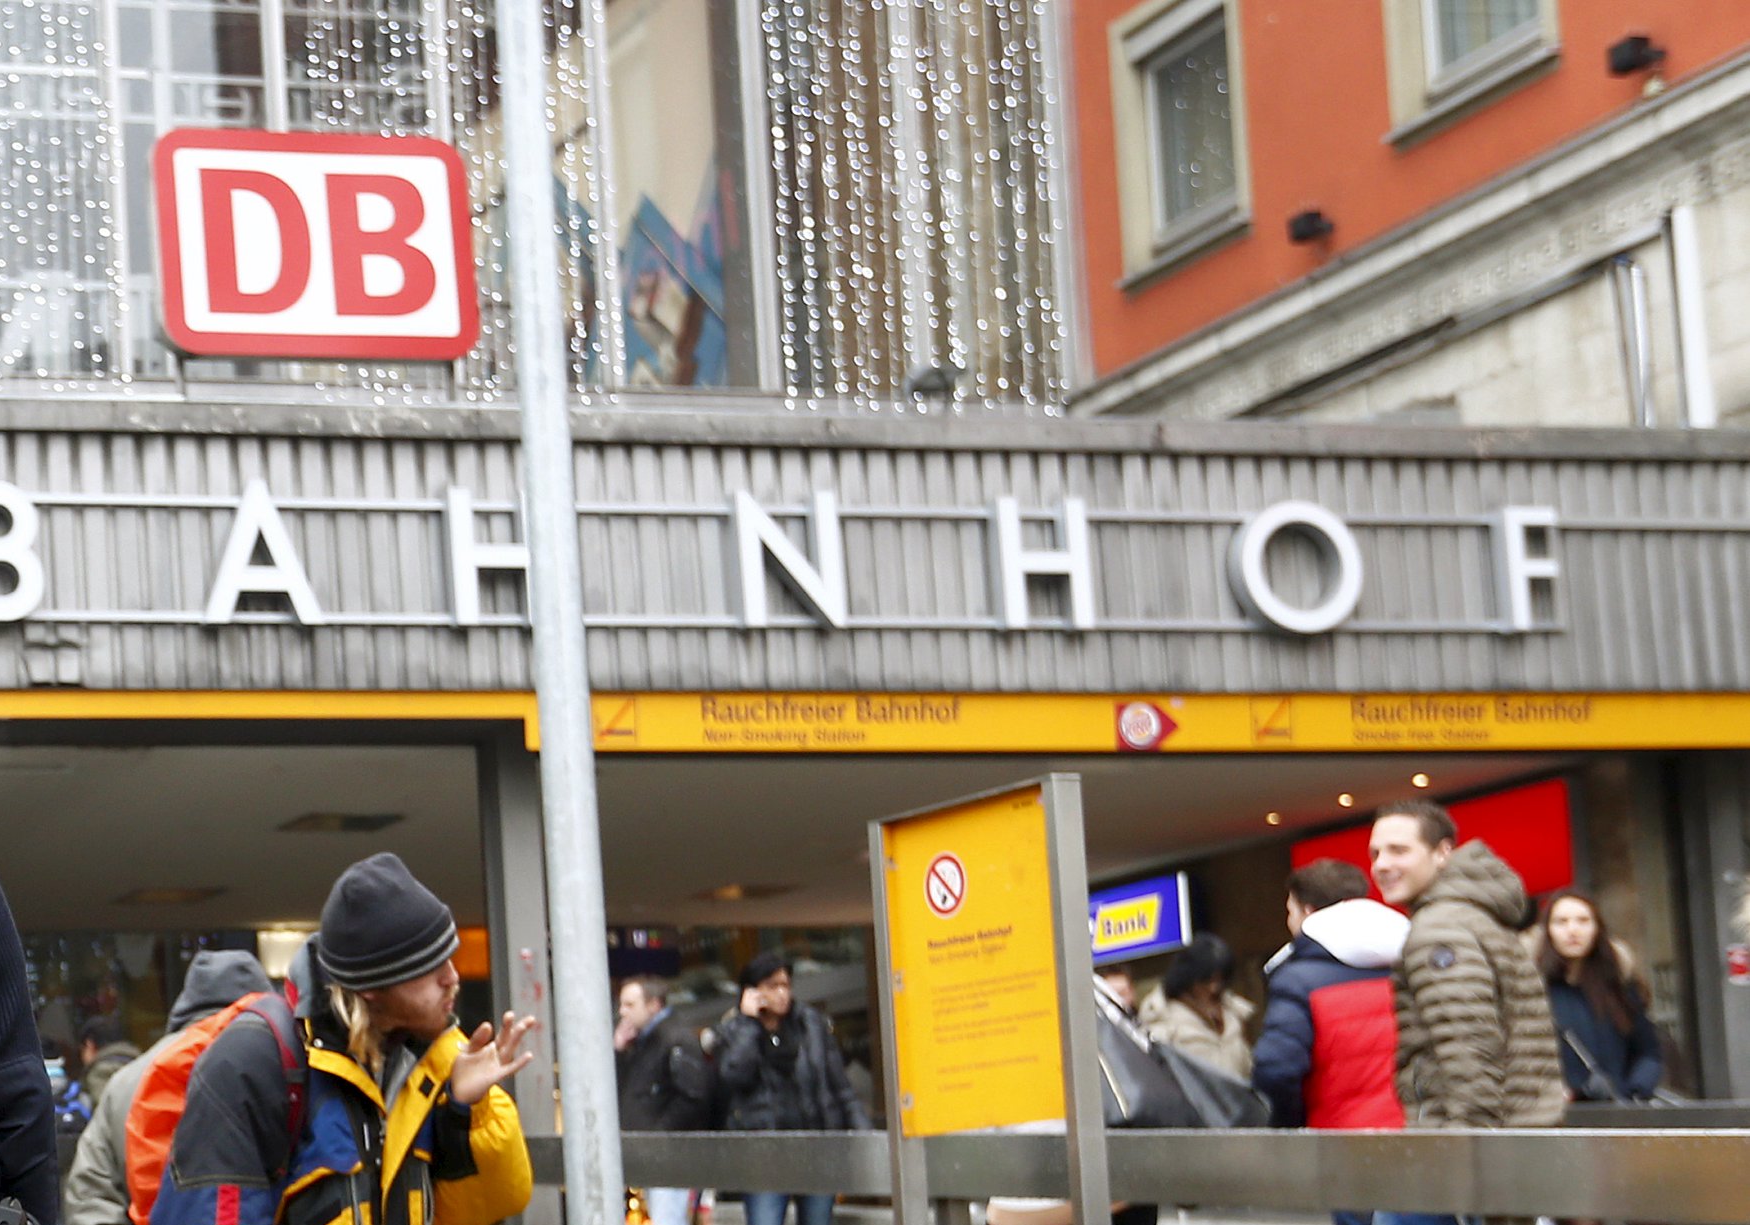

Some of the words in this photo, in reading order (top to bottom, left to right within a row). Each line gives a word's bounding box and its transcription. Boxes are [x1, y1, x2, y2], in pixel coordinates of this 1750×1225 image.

[198, 168, 437, 316] DB
[701, 695, 847, 724] Rauchfreier
[856, 695, 961, 724] Bahnhof
[1351, 695, 1486, 724] Rauchfreier
[1494, 695, 1592, 724] Bahnhof
[815, 728, 867, 742] Station
[1102, 909, 1148, 937] Bank
